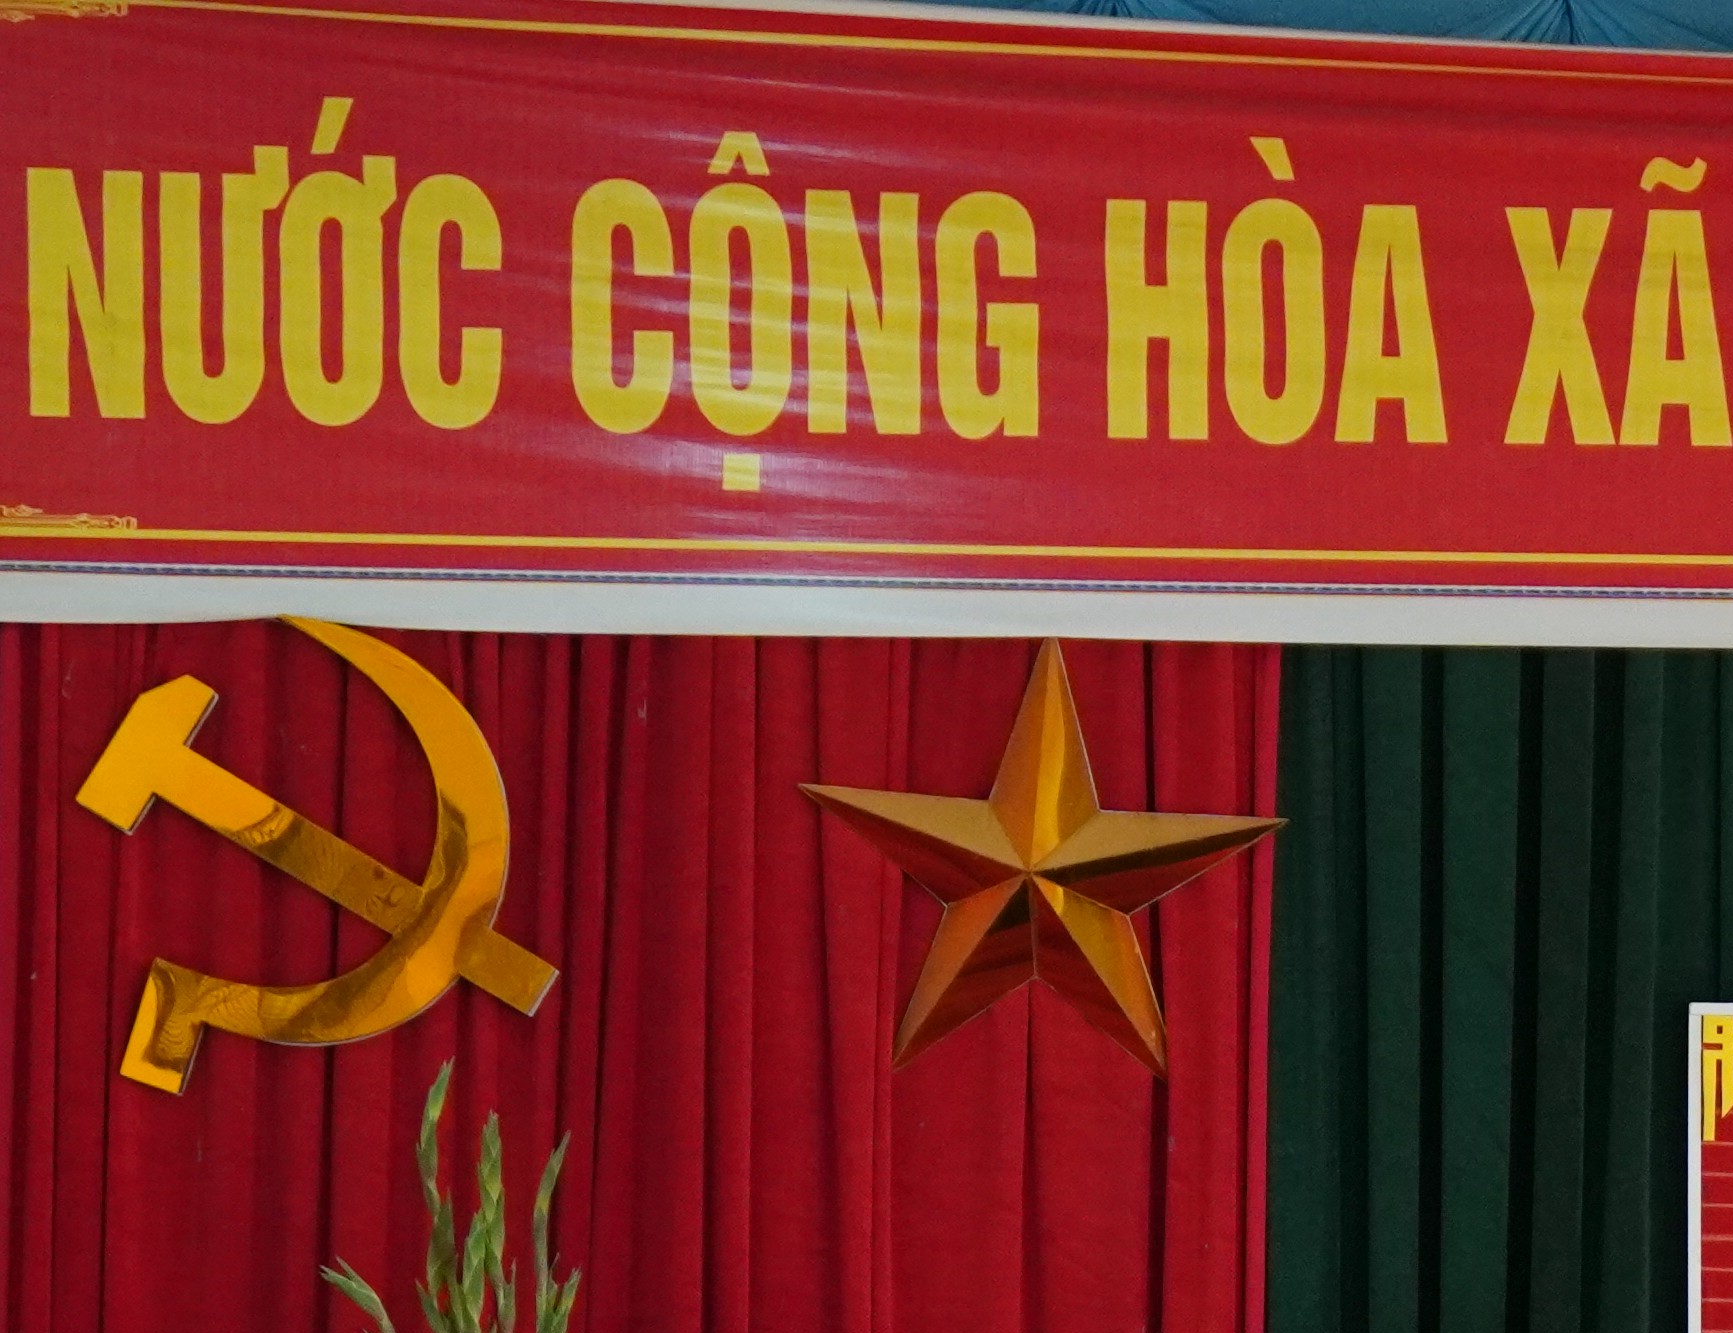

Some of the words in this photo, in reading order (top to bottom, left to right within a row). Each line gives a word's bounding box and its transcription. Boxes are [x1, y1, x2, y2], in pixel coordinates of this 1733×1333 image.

[28, 97, 502, 429] NƯỚC
[571, 132, 1040, 491] CỘNG
[1105, 138, 1448, 445] HÒA
[1506, 159, 1732, 447] XÃ
